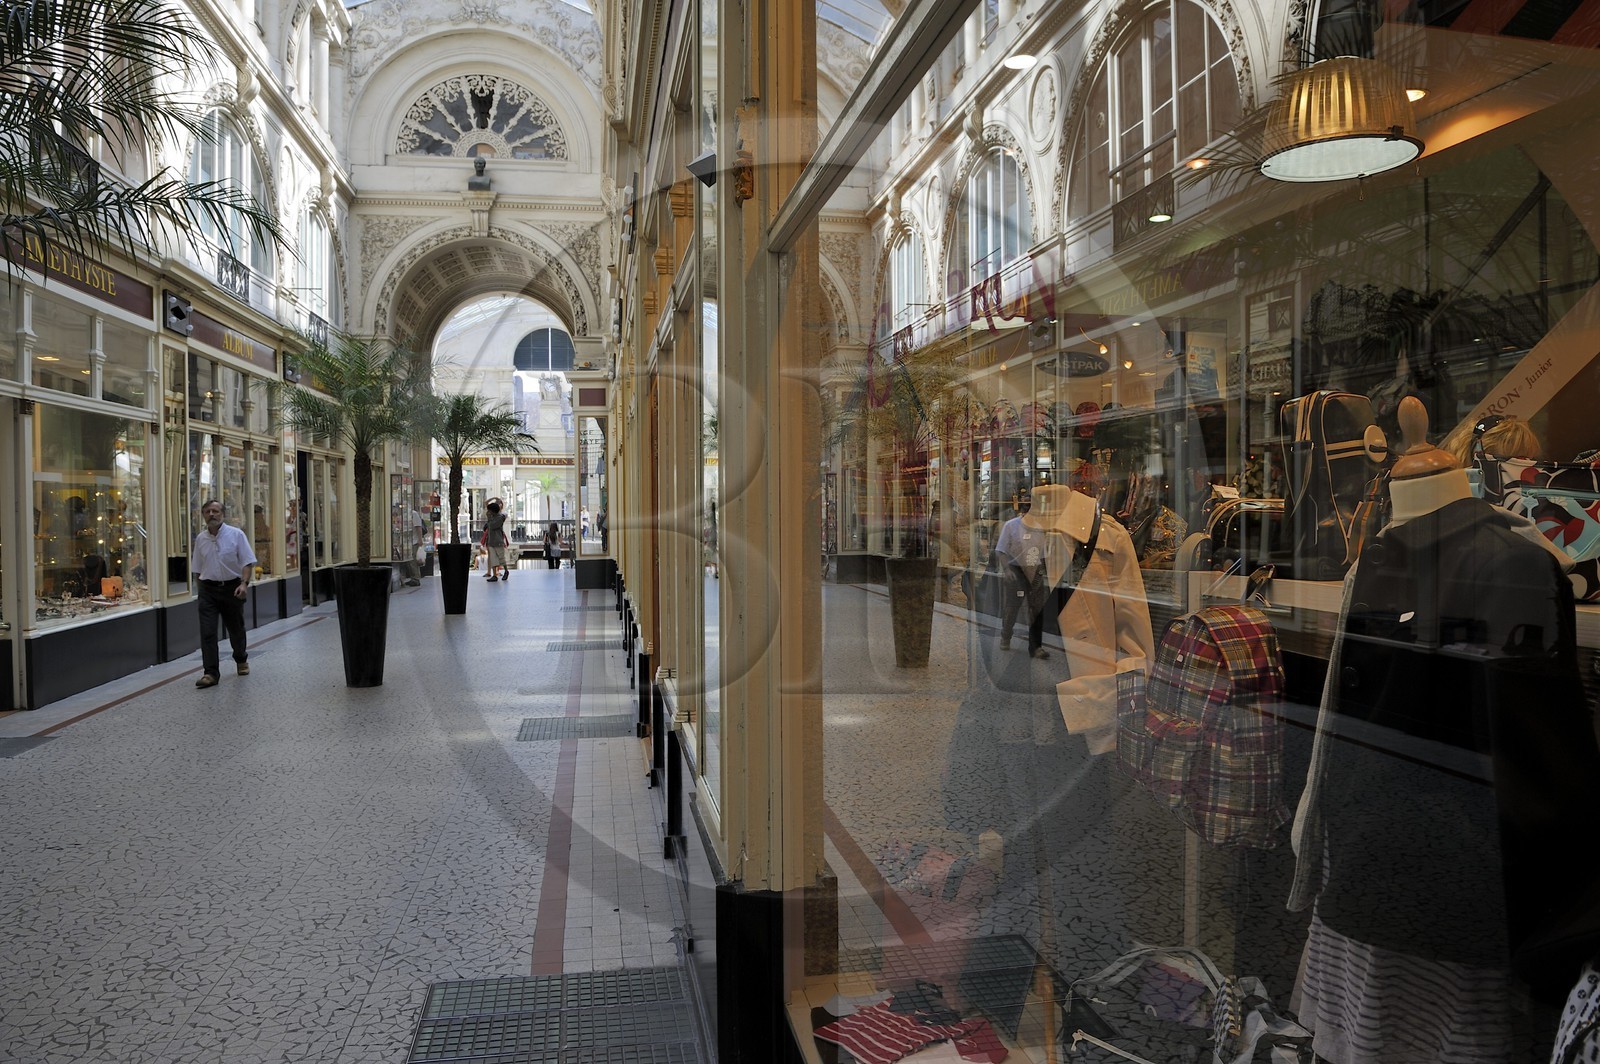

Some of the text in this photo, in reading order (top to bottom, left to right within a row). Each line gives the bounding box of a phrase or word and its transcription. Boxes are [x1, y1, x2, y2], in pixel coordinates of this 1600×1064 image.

[20, 233, 117, 297] AMETHYSTE
[222, 331, 254, 361] ALBUM
[1044, 361, 1103, 371] EASTPAK
[1525, 357, 1553, 389] Junior
[520, 457, 568, 465] OPTICIEN
